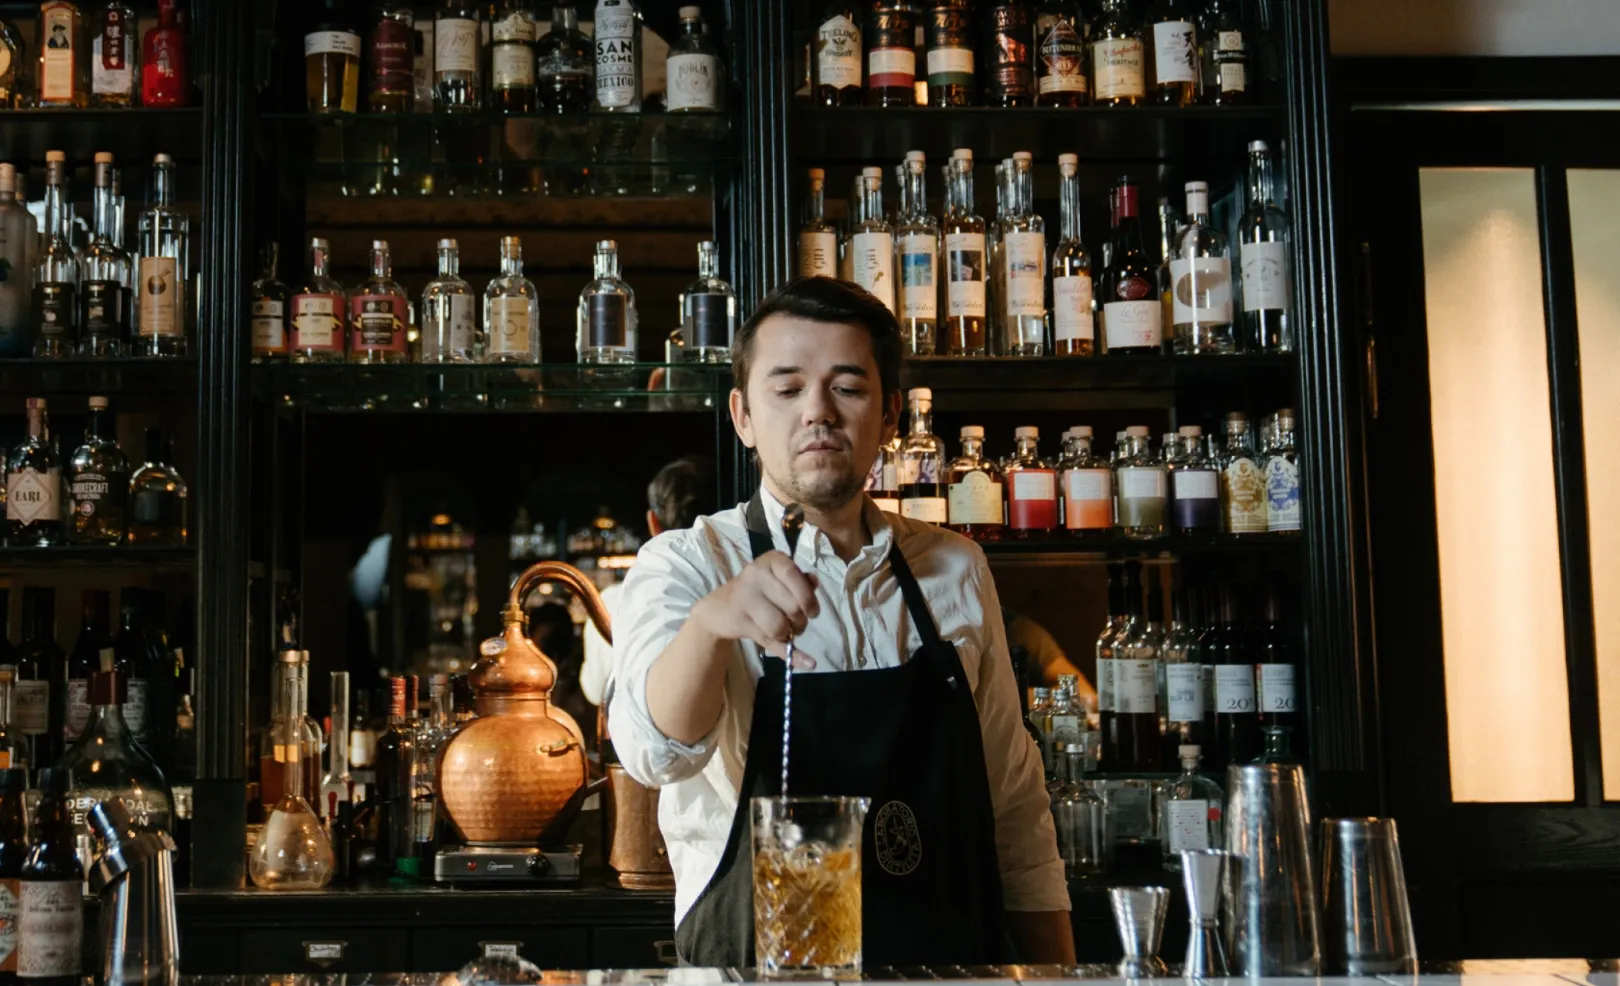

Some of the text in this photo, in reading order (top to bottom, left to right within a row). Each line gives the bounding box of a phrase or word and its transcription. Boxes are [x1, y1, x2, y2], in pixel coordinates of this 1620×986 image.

[820, 27, 857, 44] TEELING
[597, 40, 633, 55] SAN
[596, 55, 633, 65] COSME
[678, 61, 709, 77] DUBLIN
[597, 76, 634, 89] MEXICO
[15, 490, 43, 503] EARL
